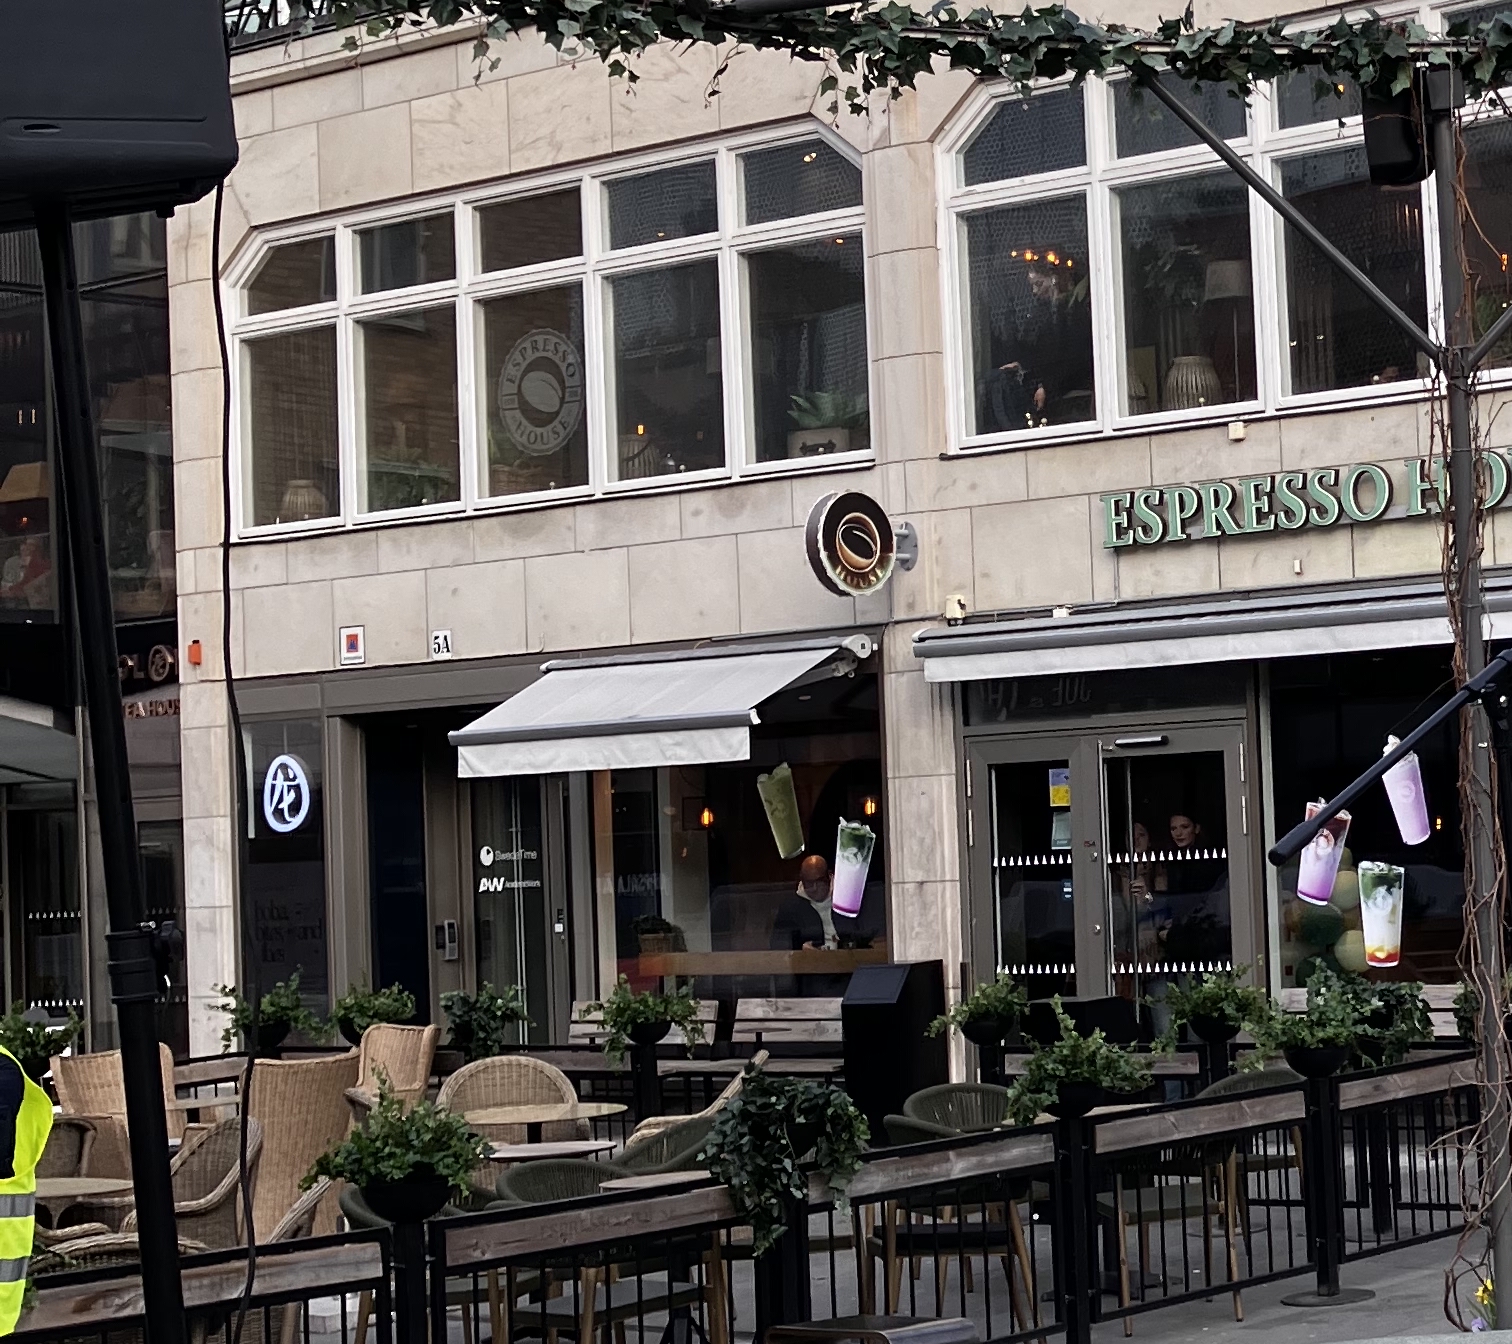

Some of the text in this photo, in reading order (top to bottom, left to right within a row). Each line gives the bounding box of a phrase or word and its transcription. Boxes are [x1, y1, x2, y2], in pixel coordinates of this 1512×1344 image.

[505, 337, 577, 386] ESPRESSO
[514, 415, 571, 446] HOUSE
[1102, 462, 1393, 549] ESPRESSO
[433, 635, 451, 654] 5A
